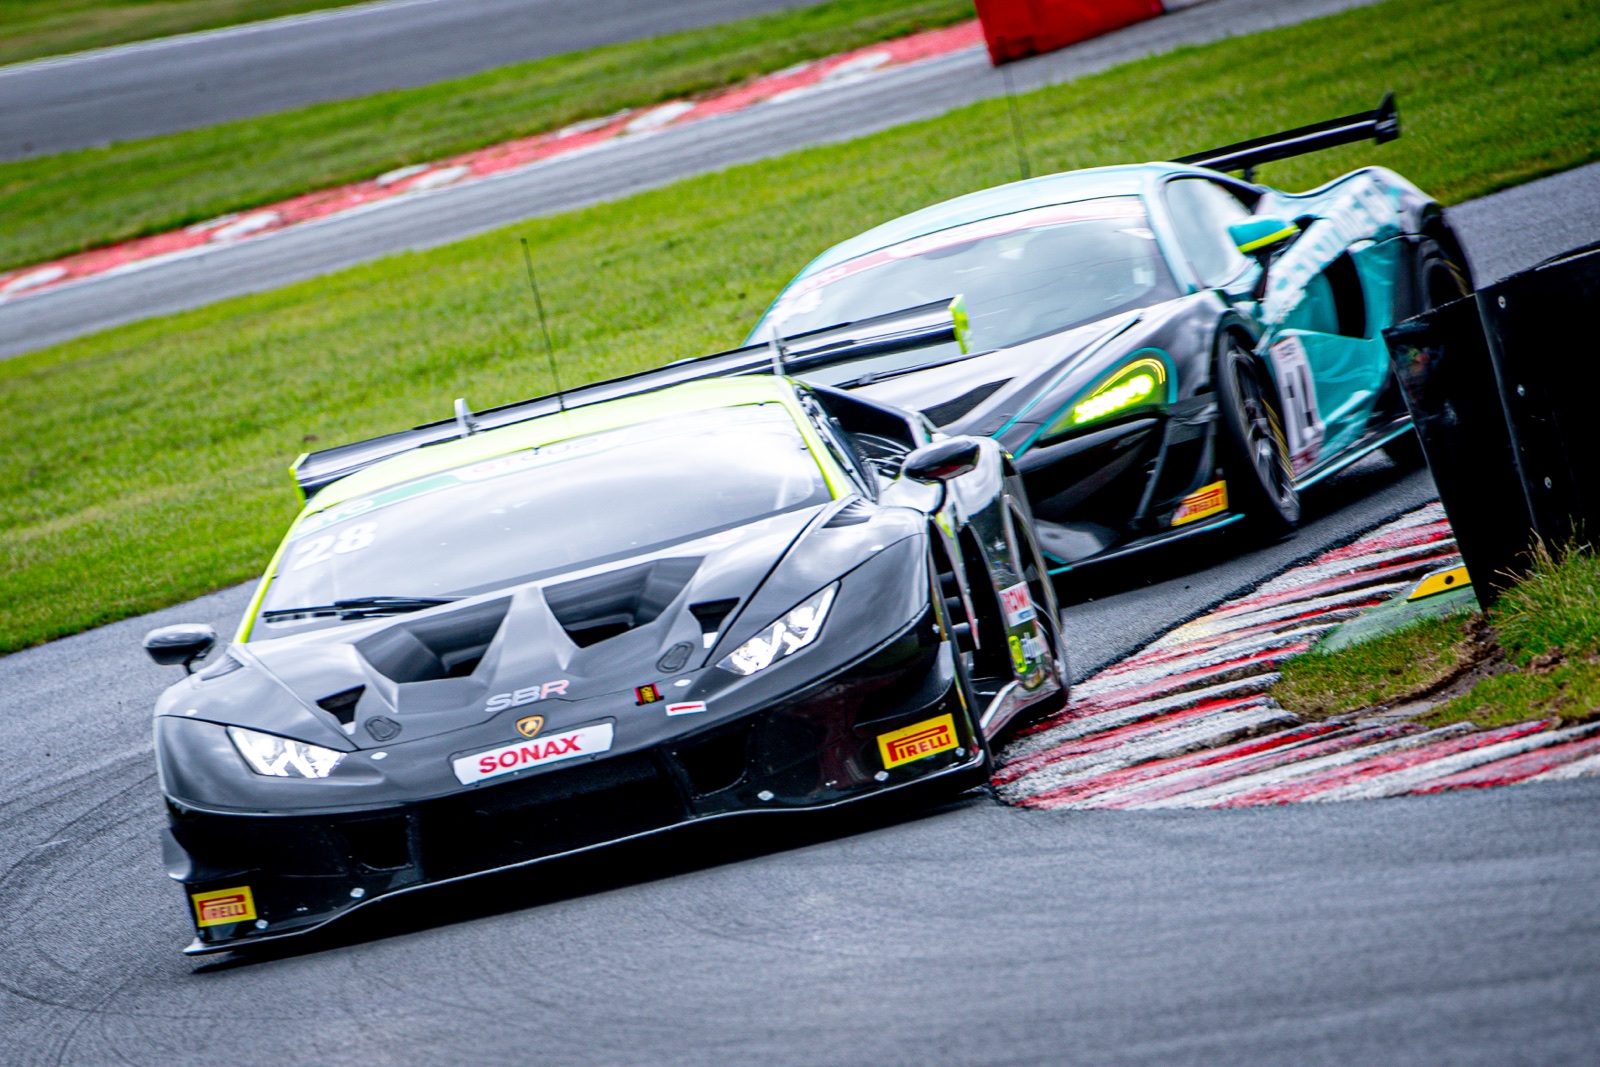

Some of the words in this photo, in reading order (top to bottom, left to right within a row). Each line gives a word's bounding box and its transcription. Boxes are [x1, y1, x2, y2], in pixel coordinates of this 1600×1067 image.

[292, 522, 379, 571] 28
[484, 680, 570, 713] SBR
[479, 734, 583, 774] SONAX
[886, 724, 951, 763] PIRELLI
